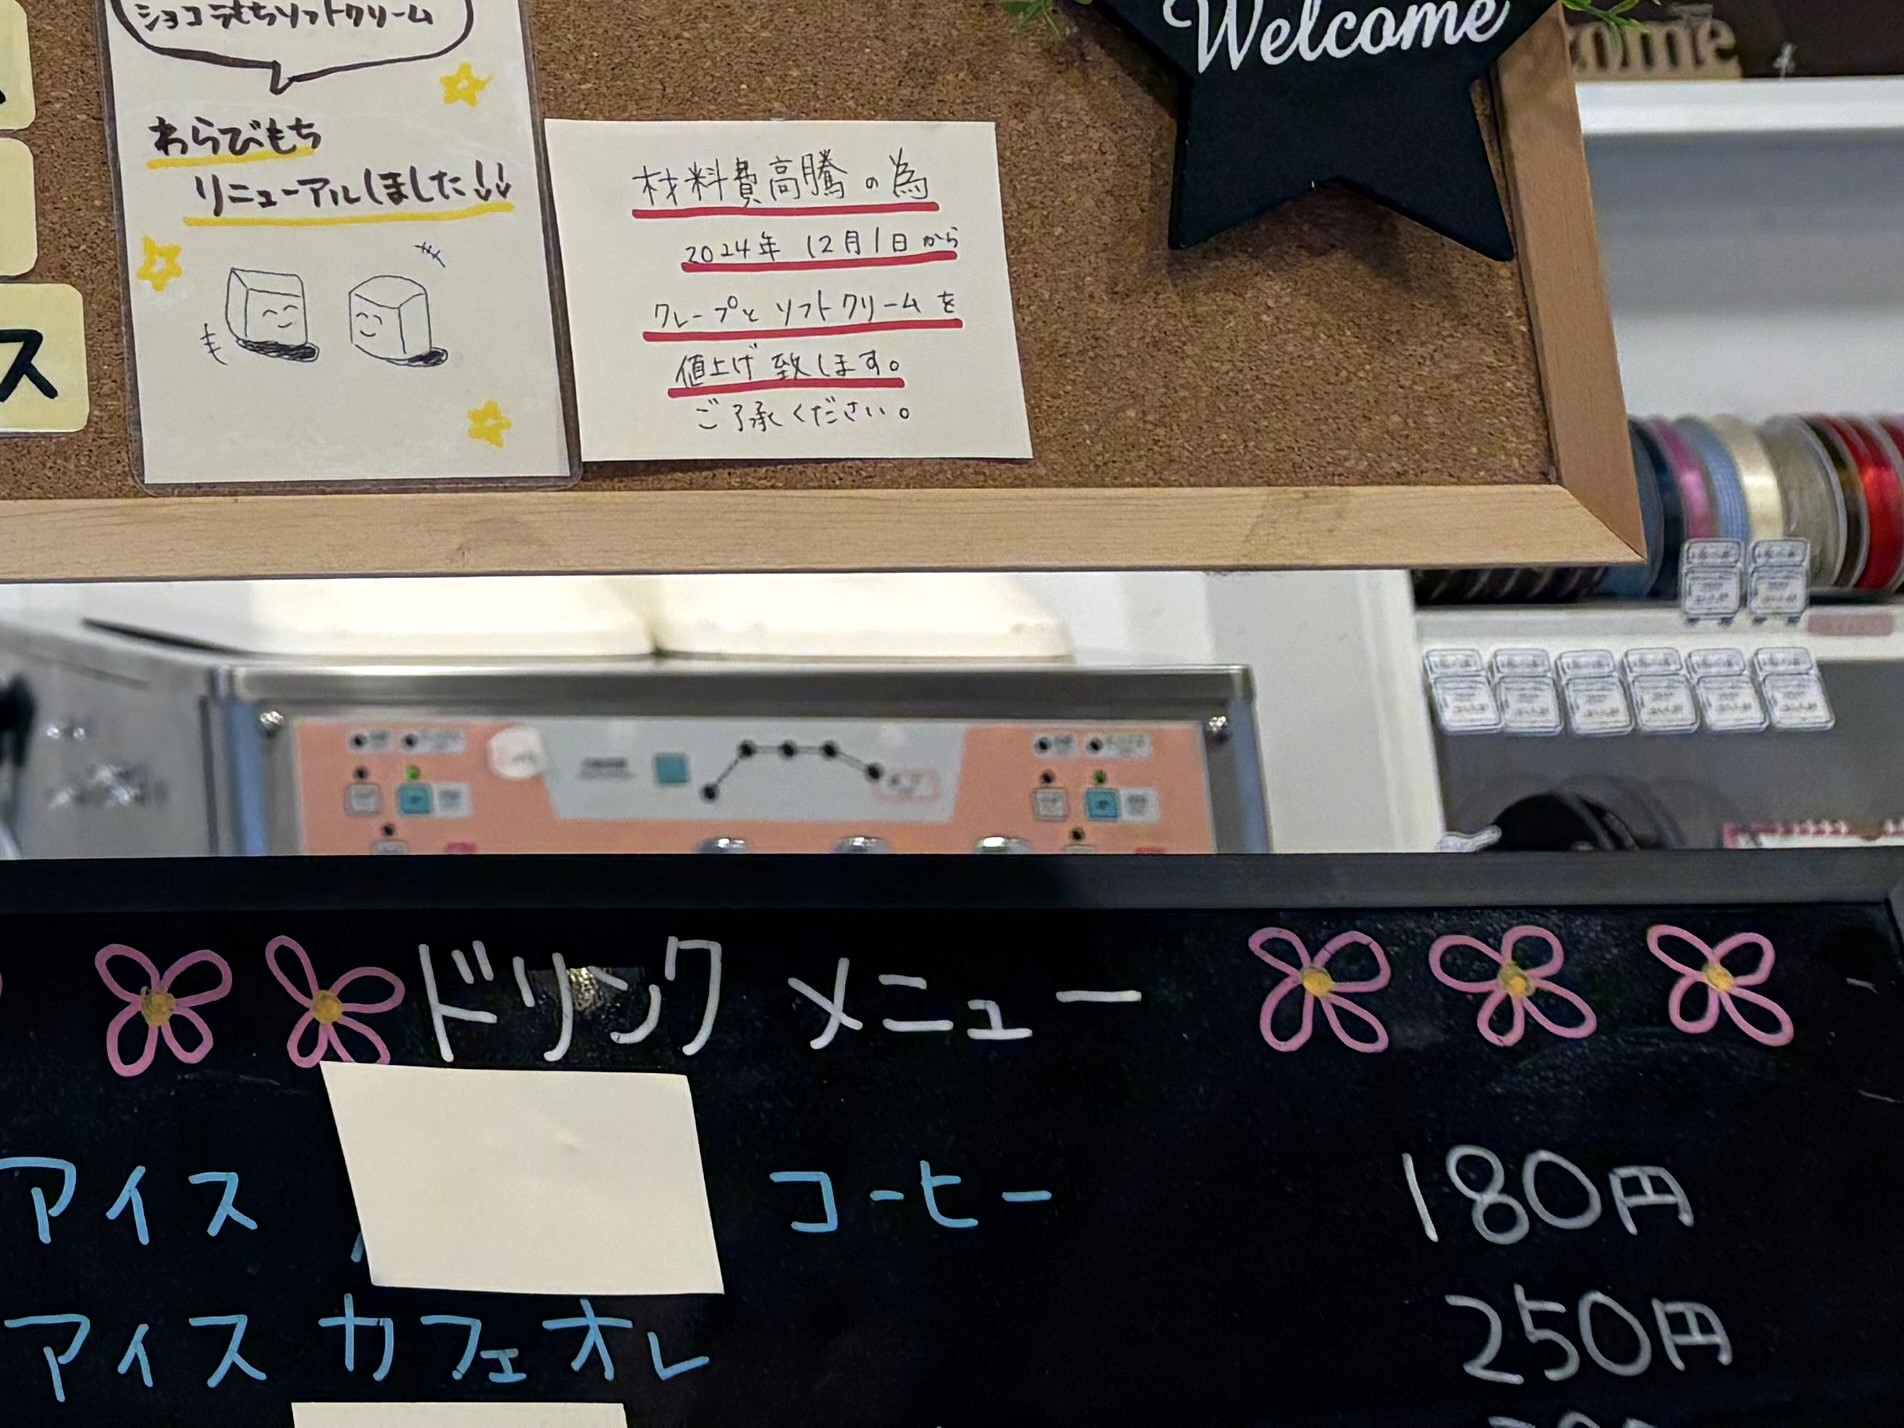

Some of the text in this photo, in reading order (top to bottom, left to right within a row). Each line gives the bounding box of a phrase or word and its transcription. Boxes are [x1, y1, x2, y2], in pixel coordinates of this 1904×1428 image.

[149, 115, 322, 156] わらびもち
[417, 935, 1143, 1064] ドリンク メニュー
[770, 1158, 1054, 1235] コーヒー
[1400, 1142, 1696, 1247] 180円
[1444, 1281, 1734, 1387] 250円
